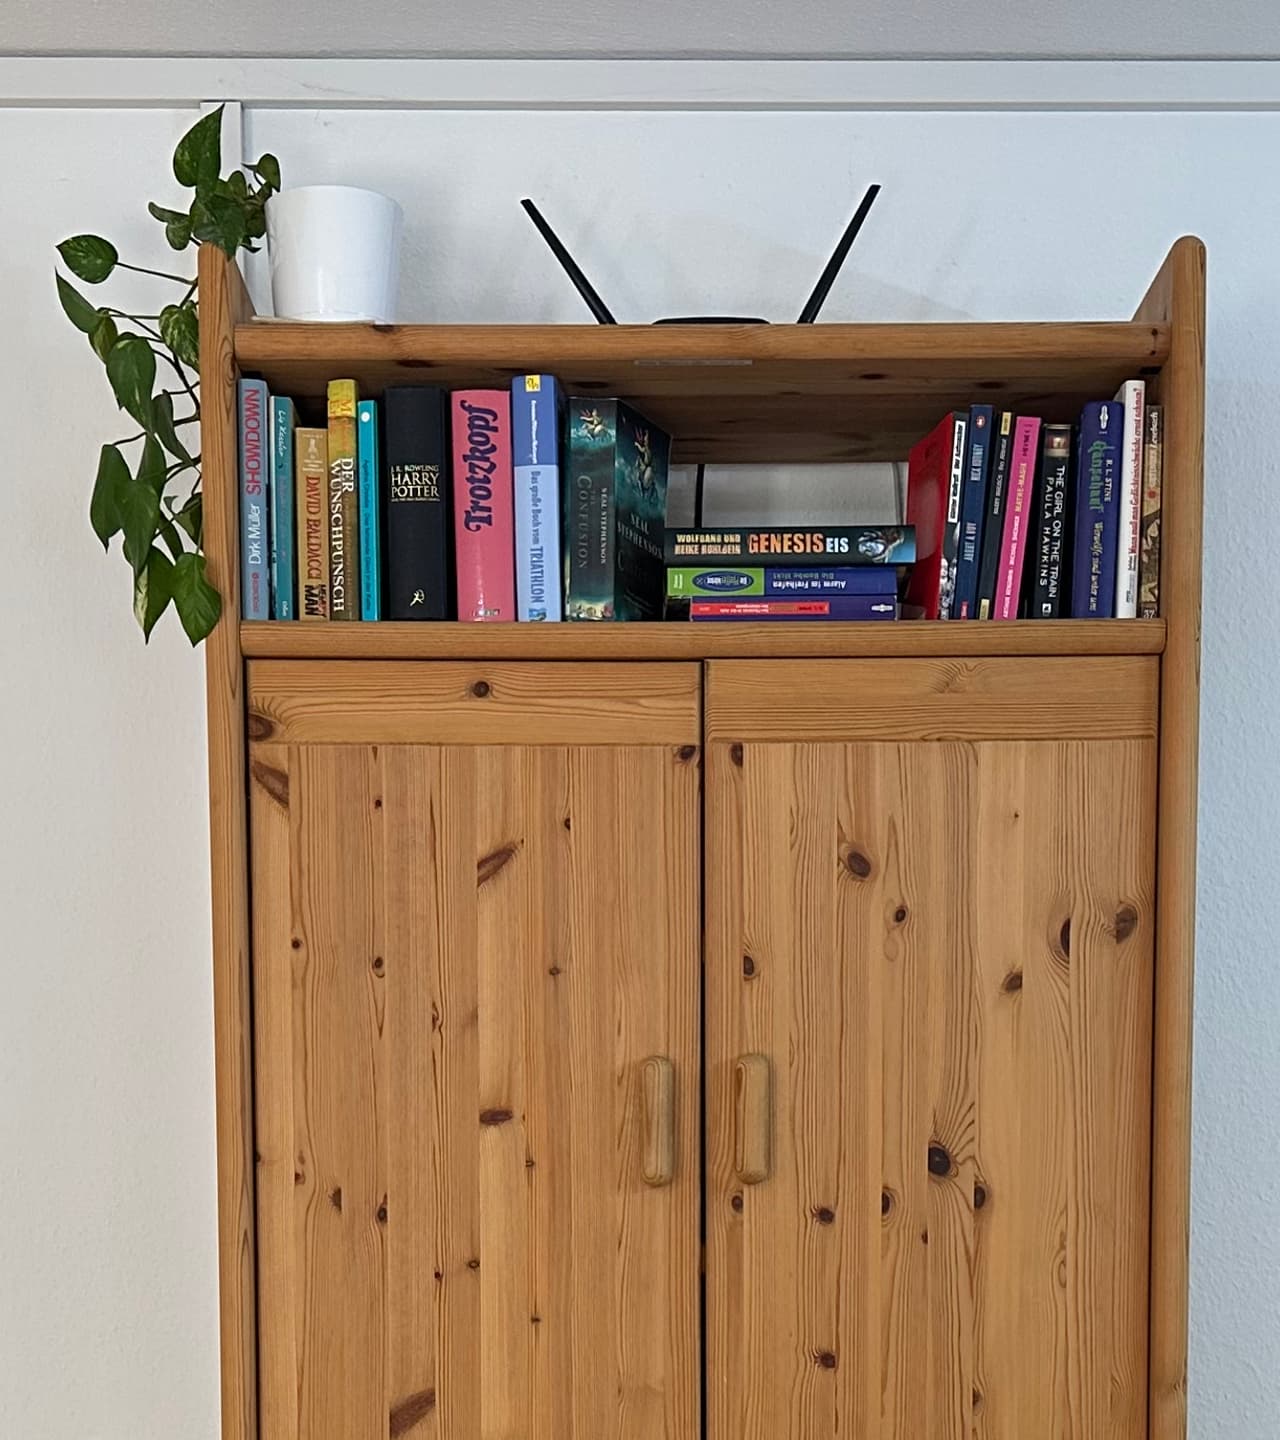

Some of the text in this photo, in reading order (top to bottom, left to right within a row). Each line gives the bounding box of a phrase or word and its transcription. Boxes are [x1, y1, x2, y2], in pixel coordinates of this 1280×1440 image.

[244, 389, 261, 496] SHOWDOWN
[460, 400, 499, 532] Trotzkopf
[306, 475, 321, 515] DAVID
[341, 457, 354, 493] DER
[391, 472, 440, 486] HARRY
[391, 485, 440, 498] POTTER
[1104, 478, 1112, 502] STINE
[306, 518, 322, 580] BALDACCI
[330, 458, 345, 612] WUNSCHPUNSCH
[577, 475, 593, 569] CONFUSION
[600, 487, 608, 564] NEAL STEPHENSON
[748, 533, 849, 554] GENESIS EIS
[1040, 477, 1055, 586] PAULA HAWKINS
[1048, 465, 1066, 598] THE GIRL ON THE TRAIN
[248, 541, 261, 564] Dirk
[530, 546, 545, 603] TRIATHLON
[304, 584, 319, 616] MAN
